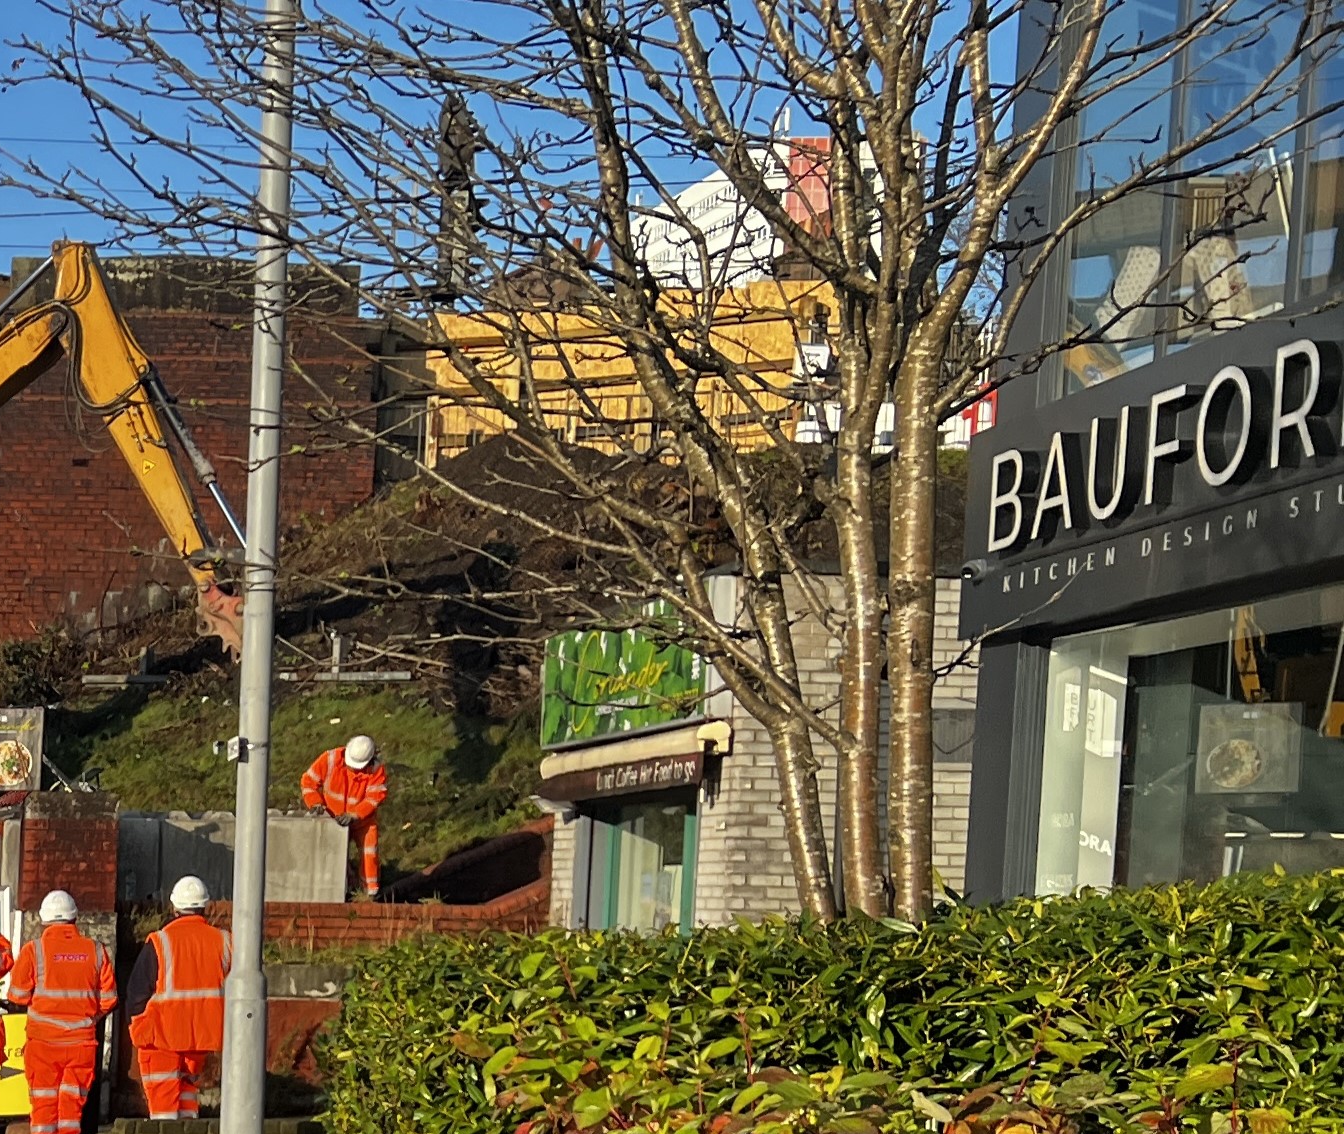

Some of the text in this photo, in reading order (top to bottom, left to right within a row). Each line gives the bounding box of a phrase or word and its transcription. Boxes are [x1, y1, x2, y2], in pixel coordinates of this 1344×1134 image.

[988, 339, 1344, 552] BAUFOR
[1002, 547, 1116, 593] KITCHEN
[1141, 509, 1258, 557] DESIGN
[616, 766, 638, 788] Coffee
[653, 758, 674, 783] Food
